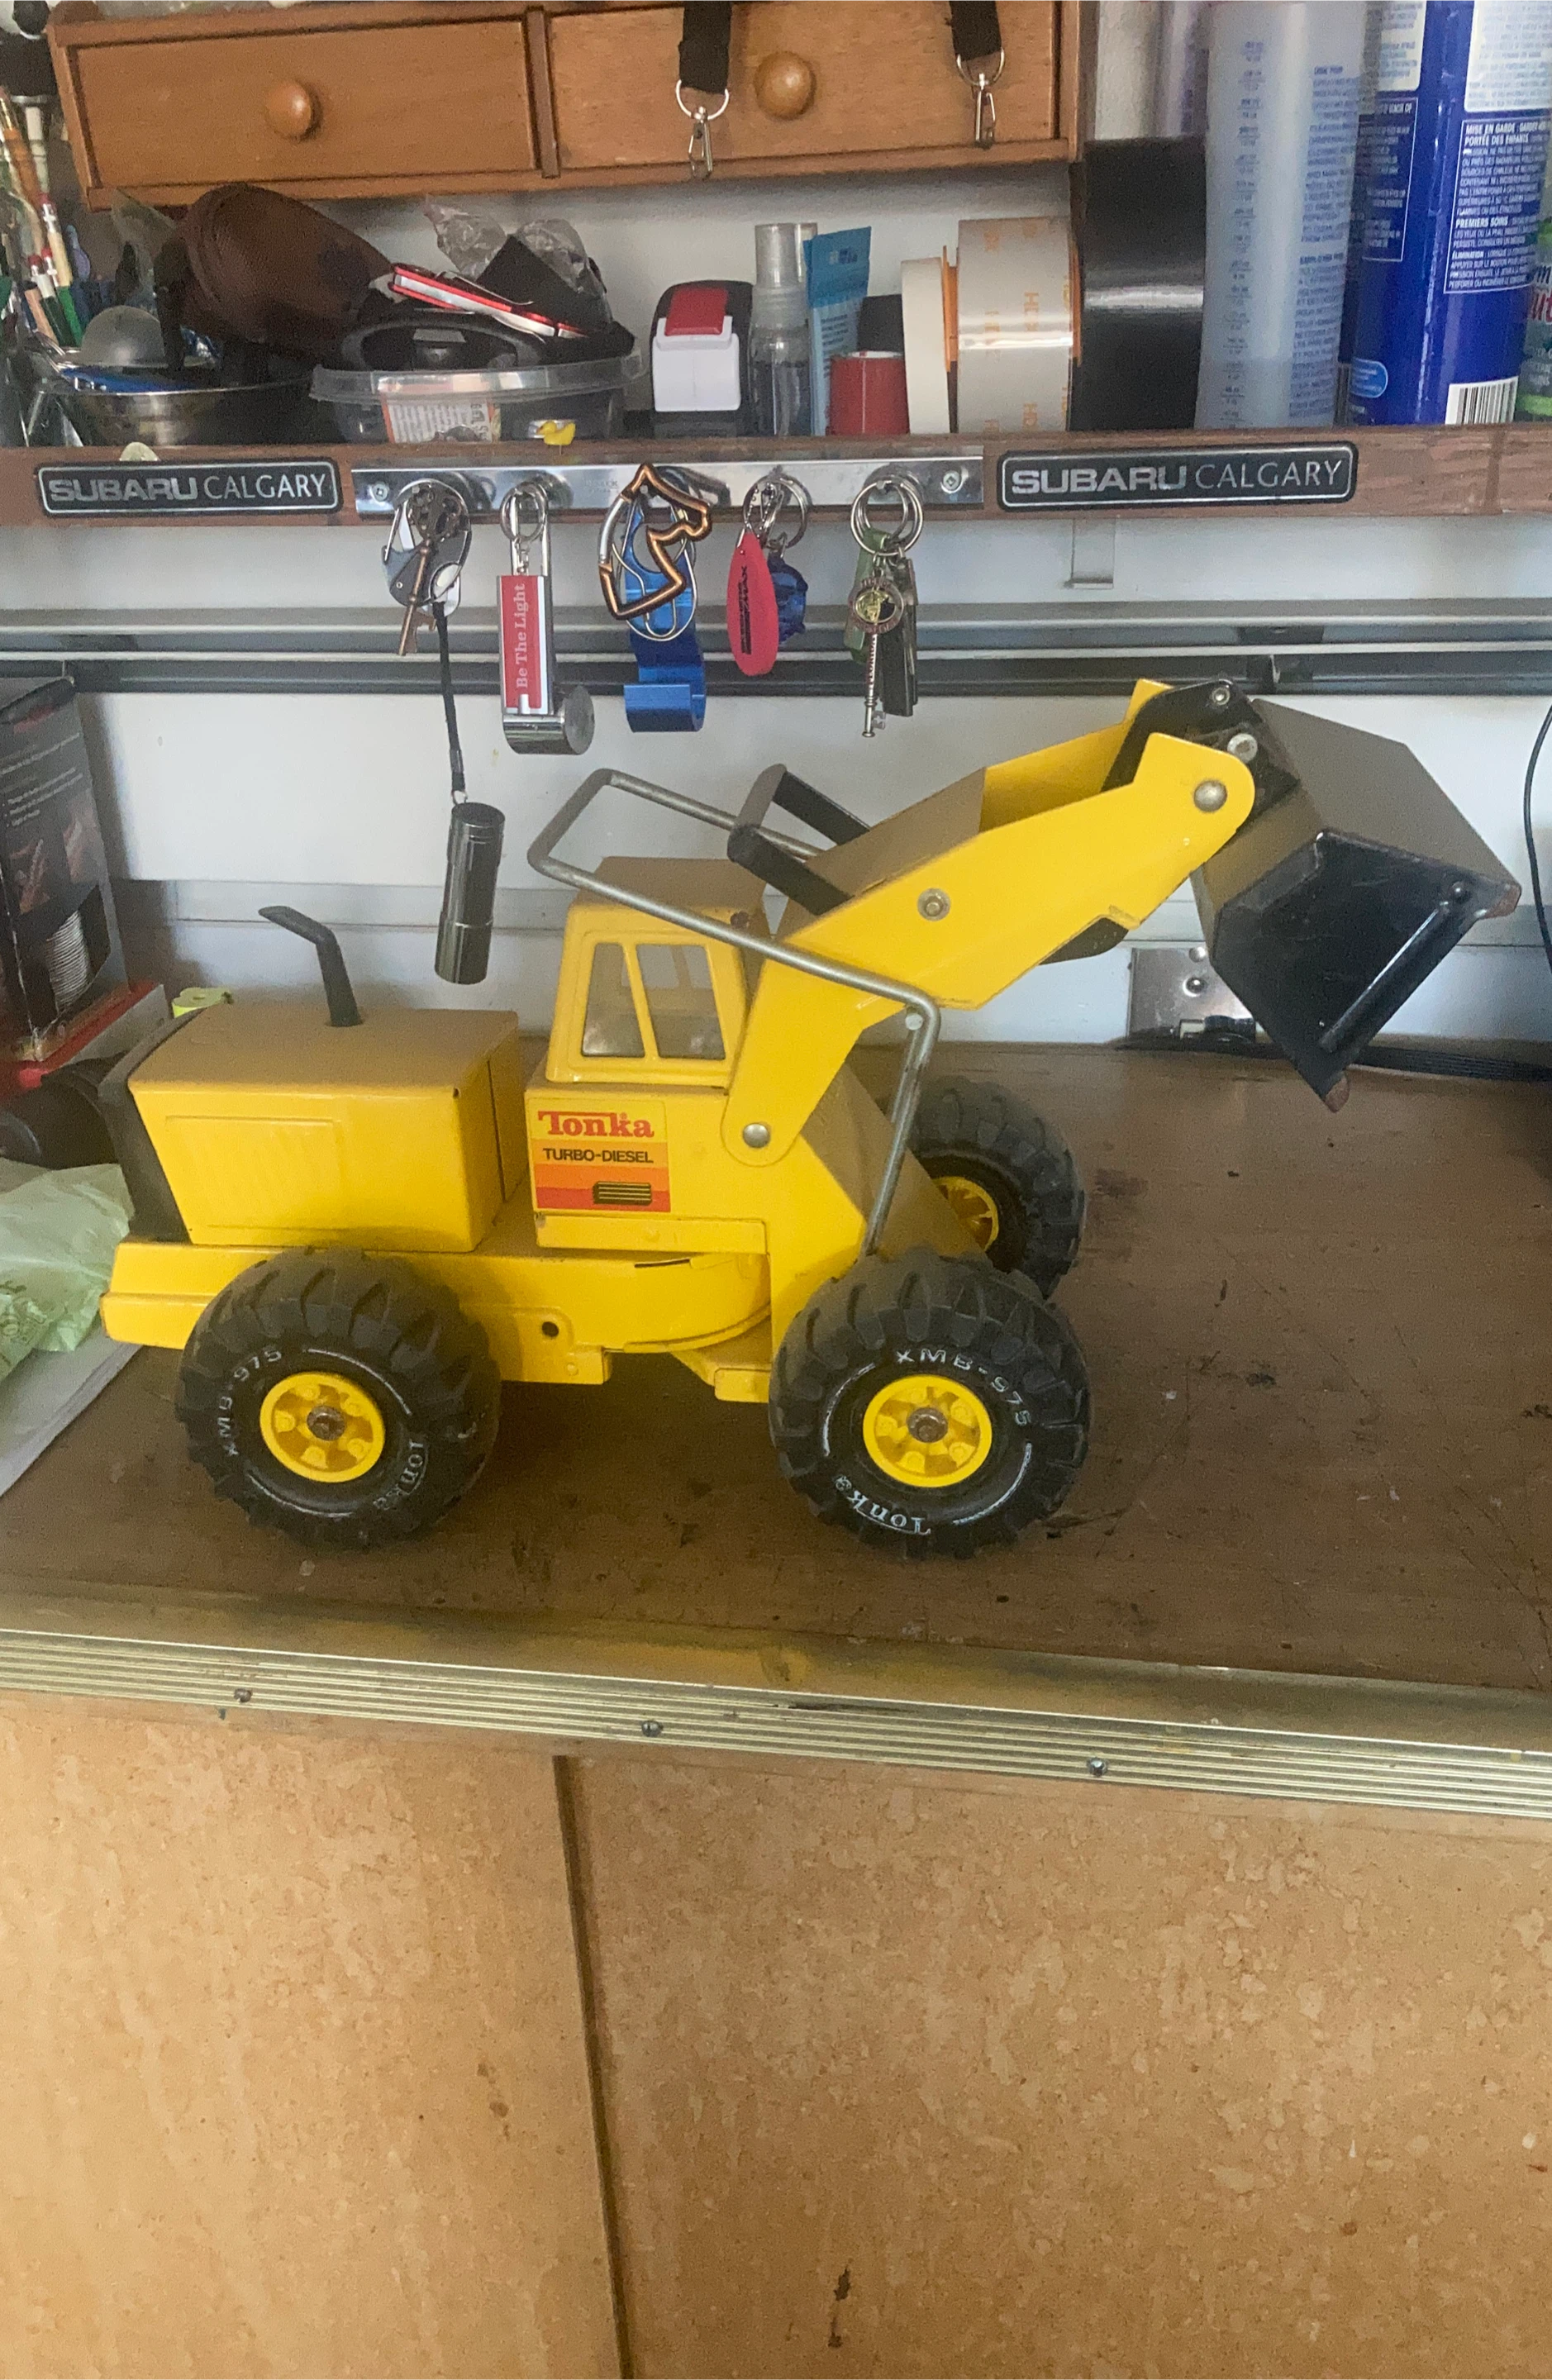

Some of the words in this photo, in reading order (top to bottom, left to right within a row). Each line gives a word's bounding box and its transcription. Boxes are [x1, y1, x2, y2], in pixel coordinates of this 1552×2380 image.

[48, 477, 198, 502] SUBARU
[203, 474, 326, 500] CALGARY
[1012, 464, 1187, 494] SUBARU
[1195, 459, 1343, 490] CALGARY
[513, 583, 528, 629] Light
[515, 631, 528, 664] The
[516, 667, 528, 688] Be
[538, 1111, 655, 1139] Tonka
[542, 1148, 655, 1164] TURBO-DIESEL
[896, 1348, 1031, 1426] XMB-975
[834, 1475, 931, 1535] Tonka
